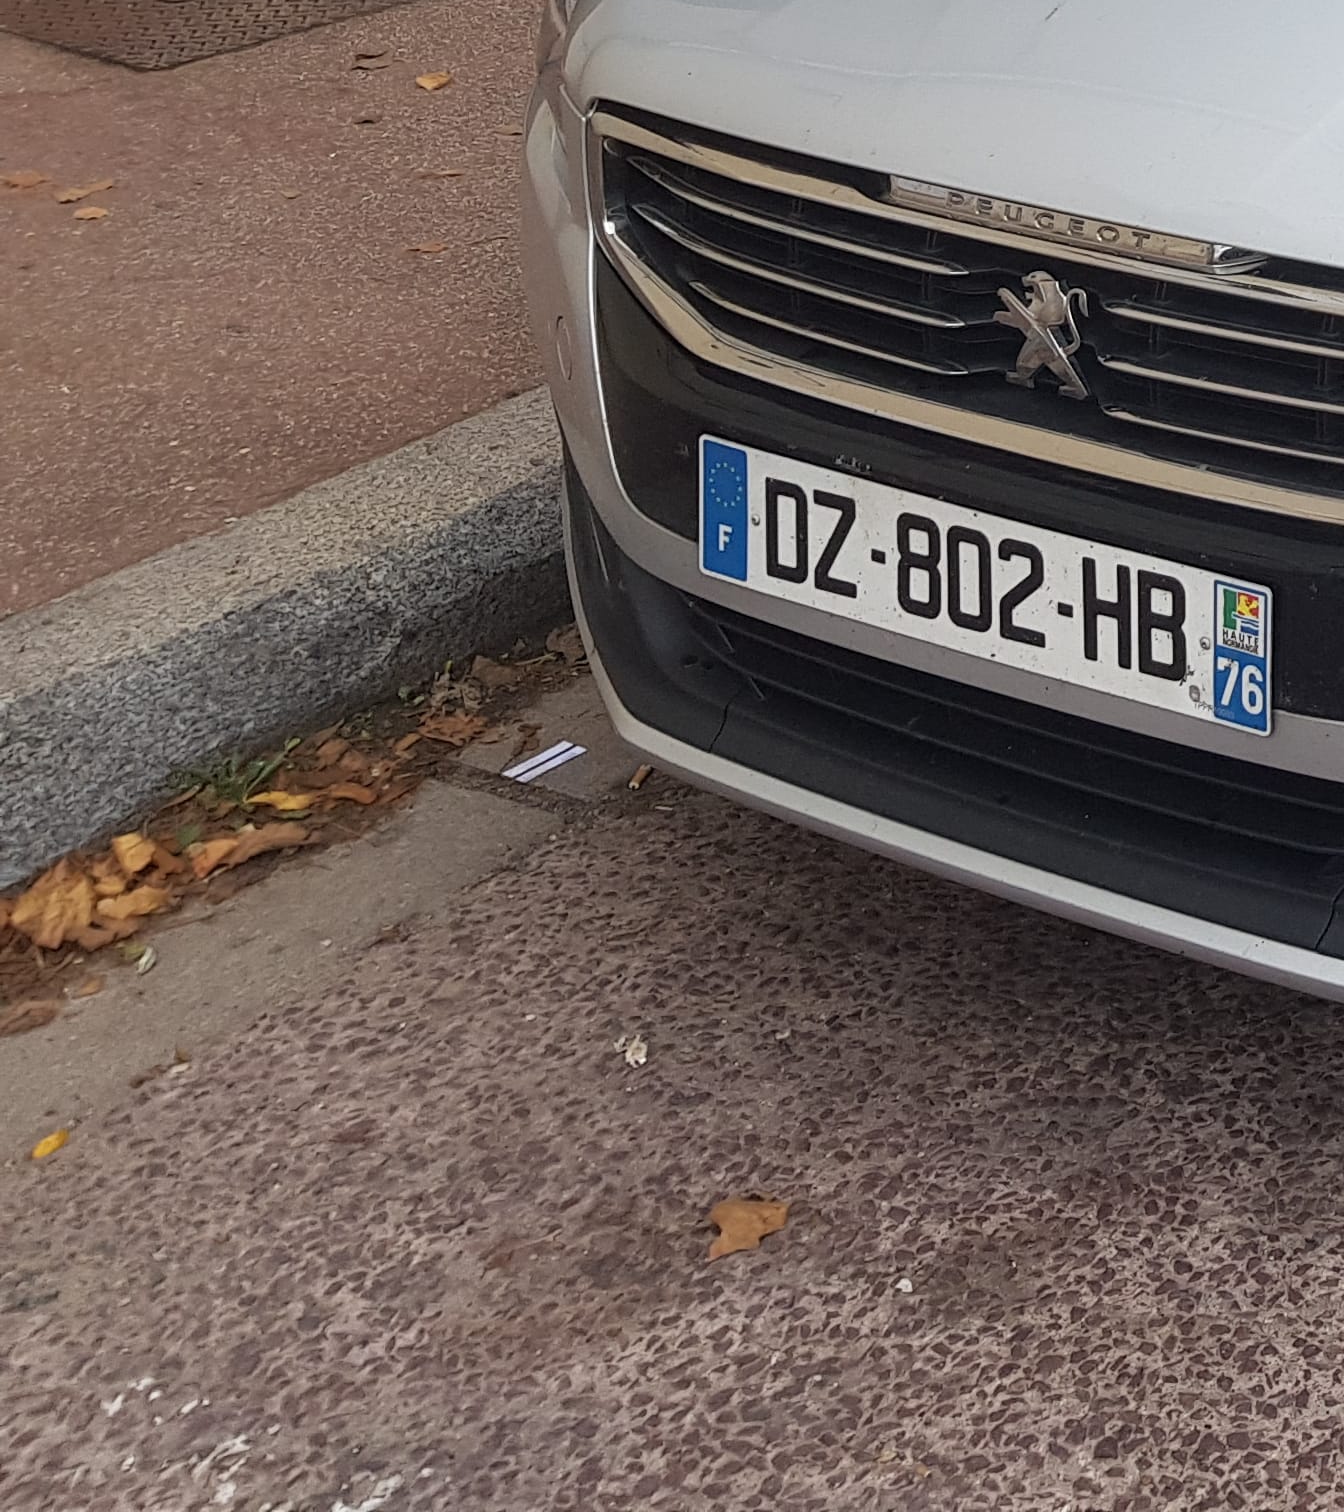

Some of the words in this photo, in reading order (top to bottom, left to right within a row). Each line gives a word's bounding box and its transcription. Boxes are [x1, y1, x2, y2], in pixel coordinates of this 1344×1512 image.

[945, 191, 1151, 249] PEUGEOT
[717, 524, 733, 553] F
[765, 476, 1187, 683] DZ-802-HB
[1222, 628, 1260, 645] HAUTE
[1216, 655, 1264, 716] 76
